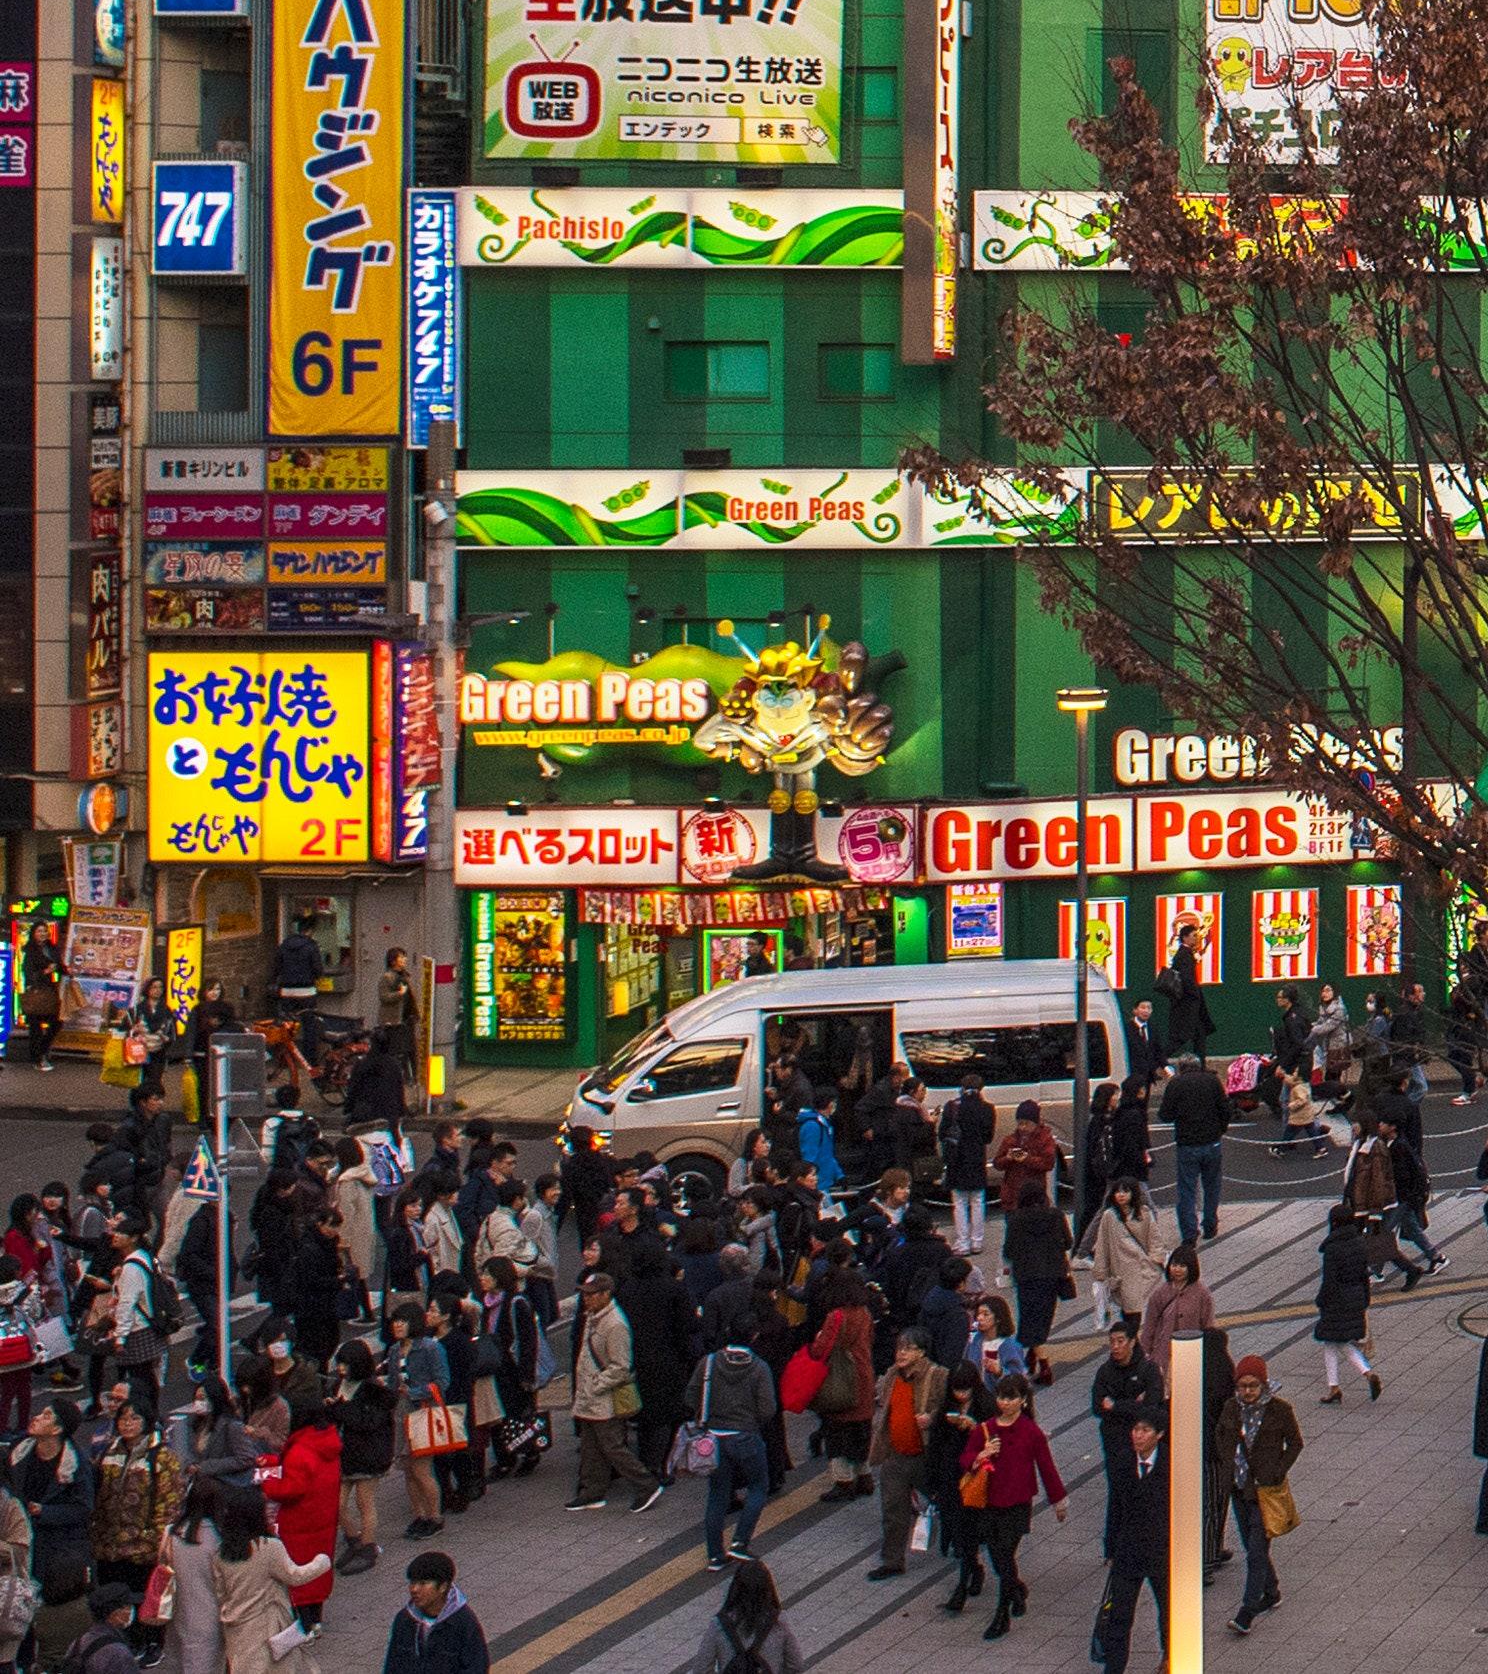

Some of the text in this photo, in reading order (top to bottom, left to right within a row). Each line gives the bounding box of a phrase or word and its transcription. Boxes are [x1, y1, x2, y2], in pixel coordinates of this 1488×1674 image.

[618, 57, 824, 85] ニコニコ生放送
[101, 84, 117, 104] 2F
[528, 81, 578, 99] WEB
[627, 89, 745, 104] niconico
[533, 102, 573, 121] 放送
[625, 122, 711, 137] エンデック
[757, 122, 795, 139] 検索
[158, 192, 230, 246] 747
[517, 215, 623, 241] Pachislo
[414, 205, 443, 384] カラオケ747
[293, 331, 381, 397] 6F
[730, 498, 864, 522] Green Peas
[154, 664, 337, 726] お好焼
[462, 672, 710, 724] Green Peas
[474, 727, 690, 747] www.greenpeas.co.jp
[301, 819, 360, 856] 2F
[462, 830, 675, 866] 選べるスロット
[700, 817, 736, 857] 新
[932, 801, 1298, 873] Green Peas
[176, 932, 195, 948] 2F
[475, 943, 494, 1037] Green Peas
